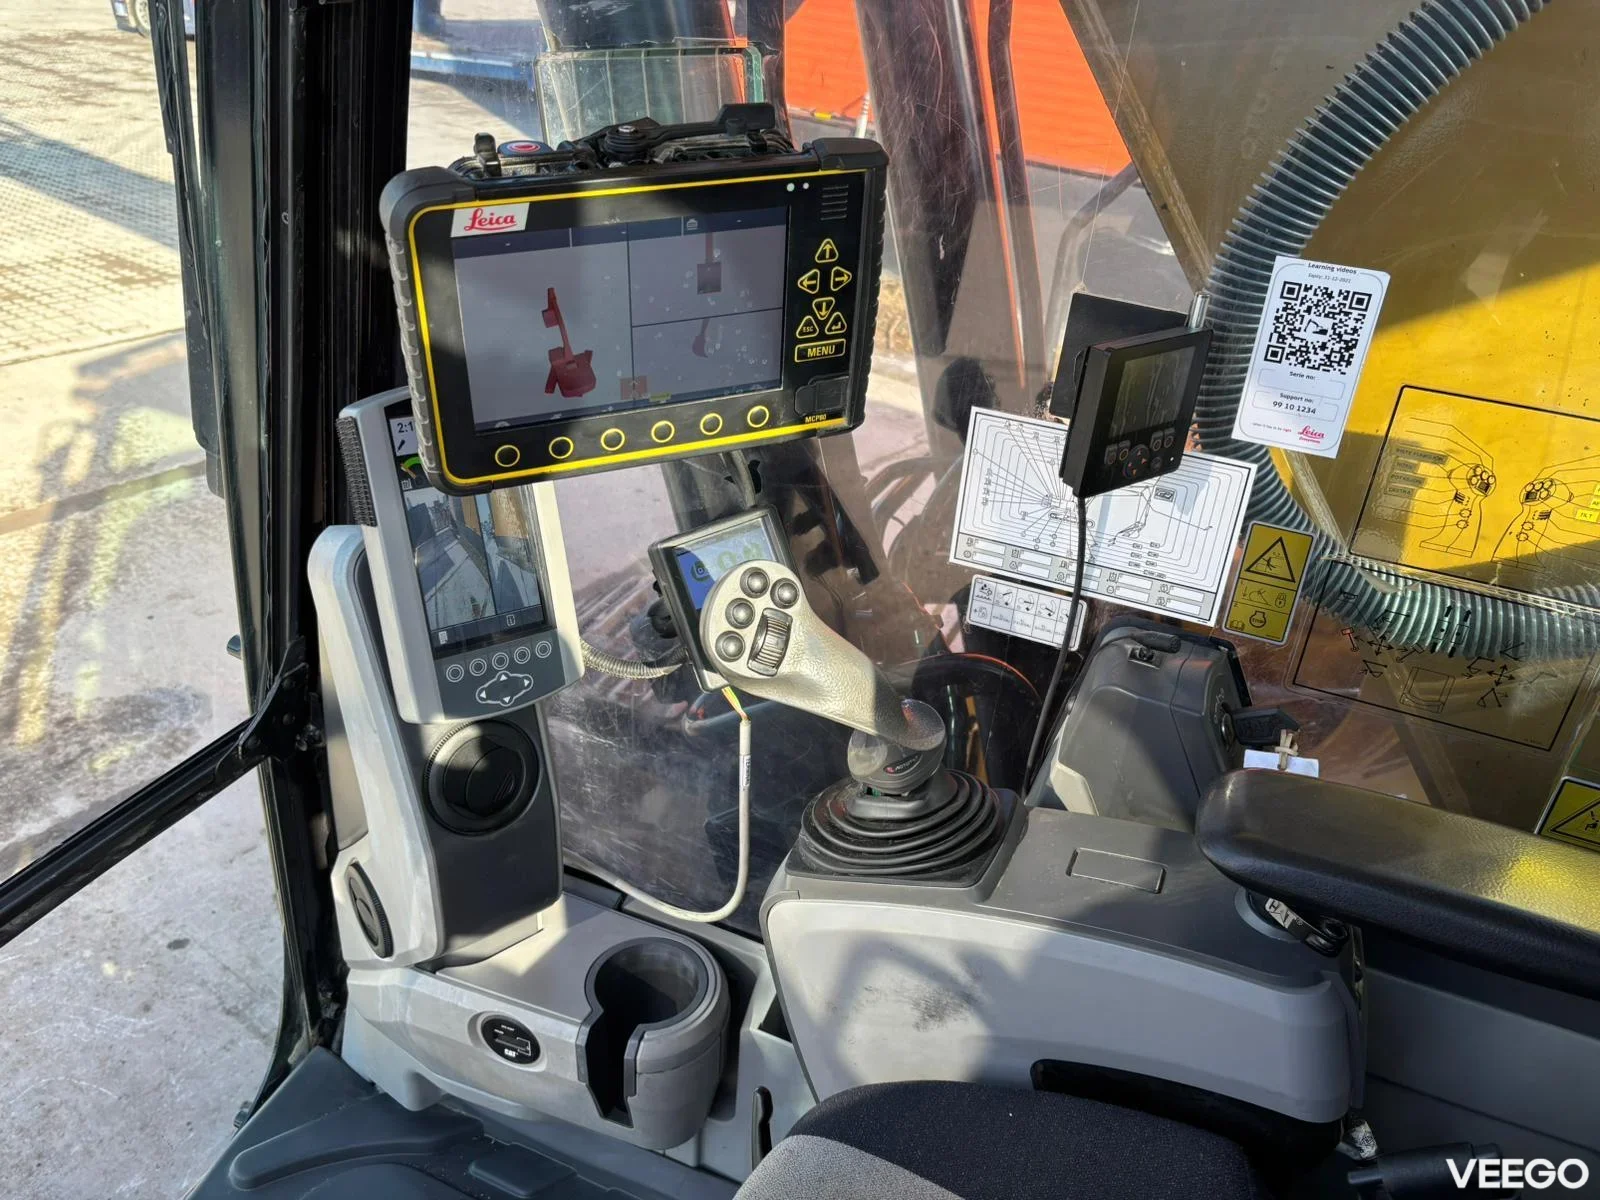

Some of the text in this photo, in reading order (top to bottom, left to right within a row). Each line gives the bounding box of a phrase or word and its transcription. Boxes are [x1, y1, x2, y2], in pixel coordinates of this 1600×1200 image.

[464, 208, 517, 231] Leica
[1308, 263, 1357, 275] Learning videos
[803, 325, 814, 333] ESC
[807, 345, 836, 358] MENU
[1280, 393, 1303, 401] Support
[1272, 400, 1317, 415] 99 10 1234
[1297, 425, 1326, 439] Leica
